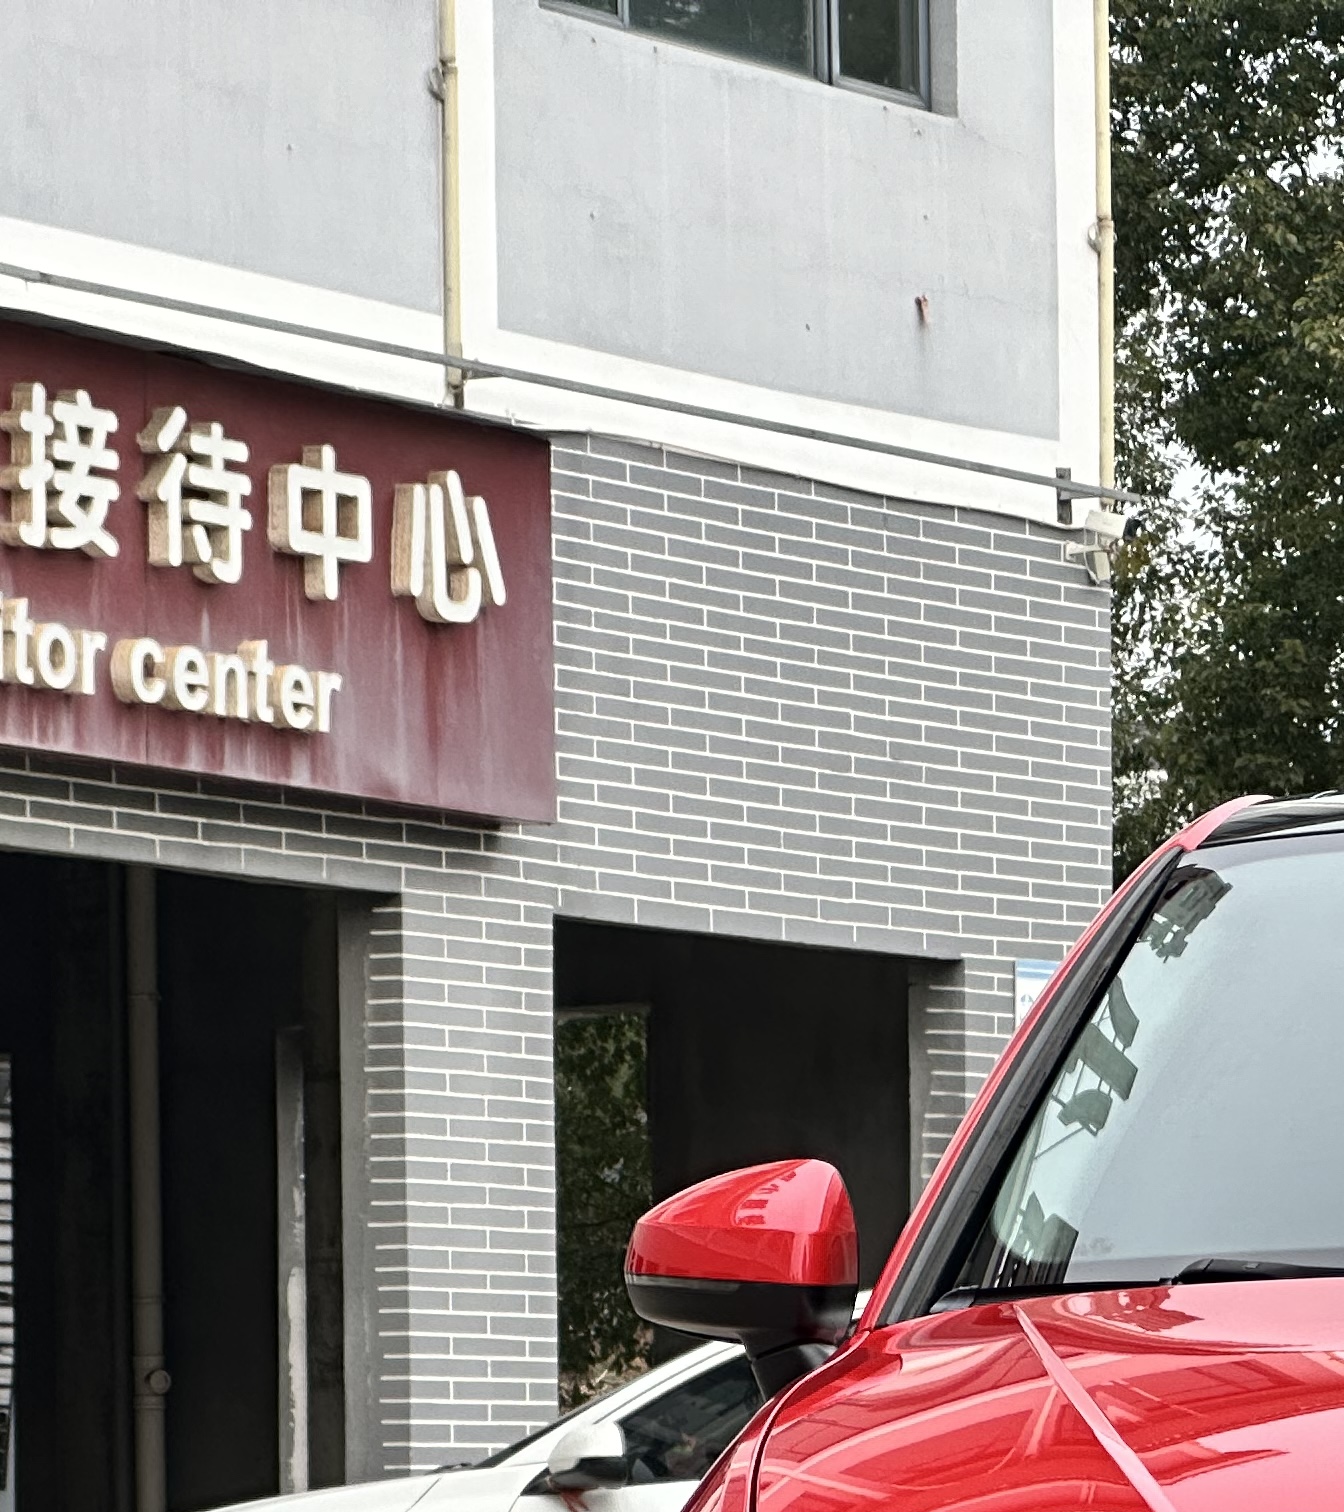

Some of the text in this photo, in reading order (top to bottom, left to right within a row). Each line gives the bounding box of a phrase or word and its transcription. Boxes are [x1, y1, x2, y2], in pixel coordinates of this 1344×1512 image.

[8, 382, 507, 624] 接待中心
[118, 636, 343, 733] center
